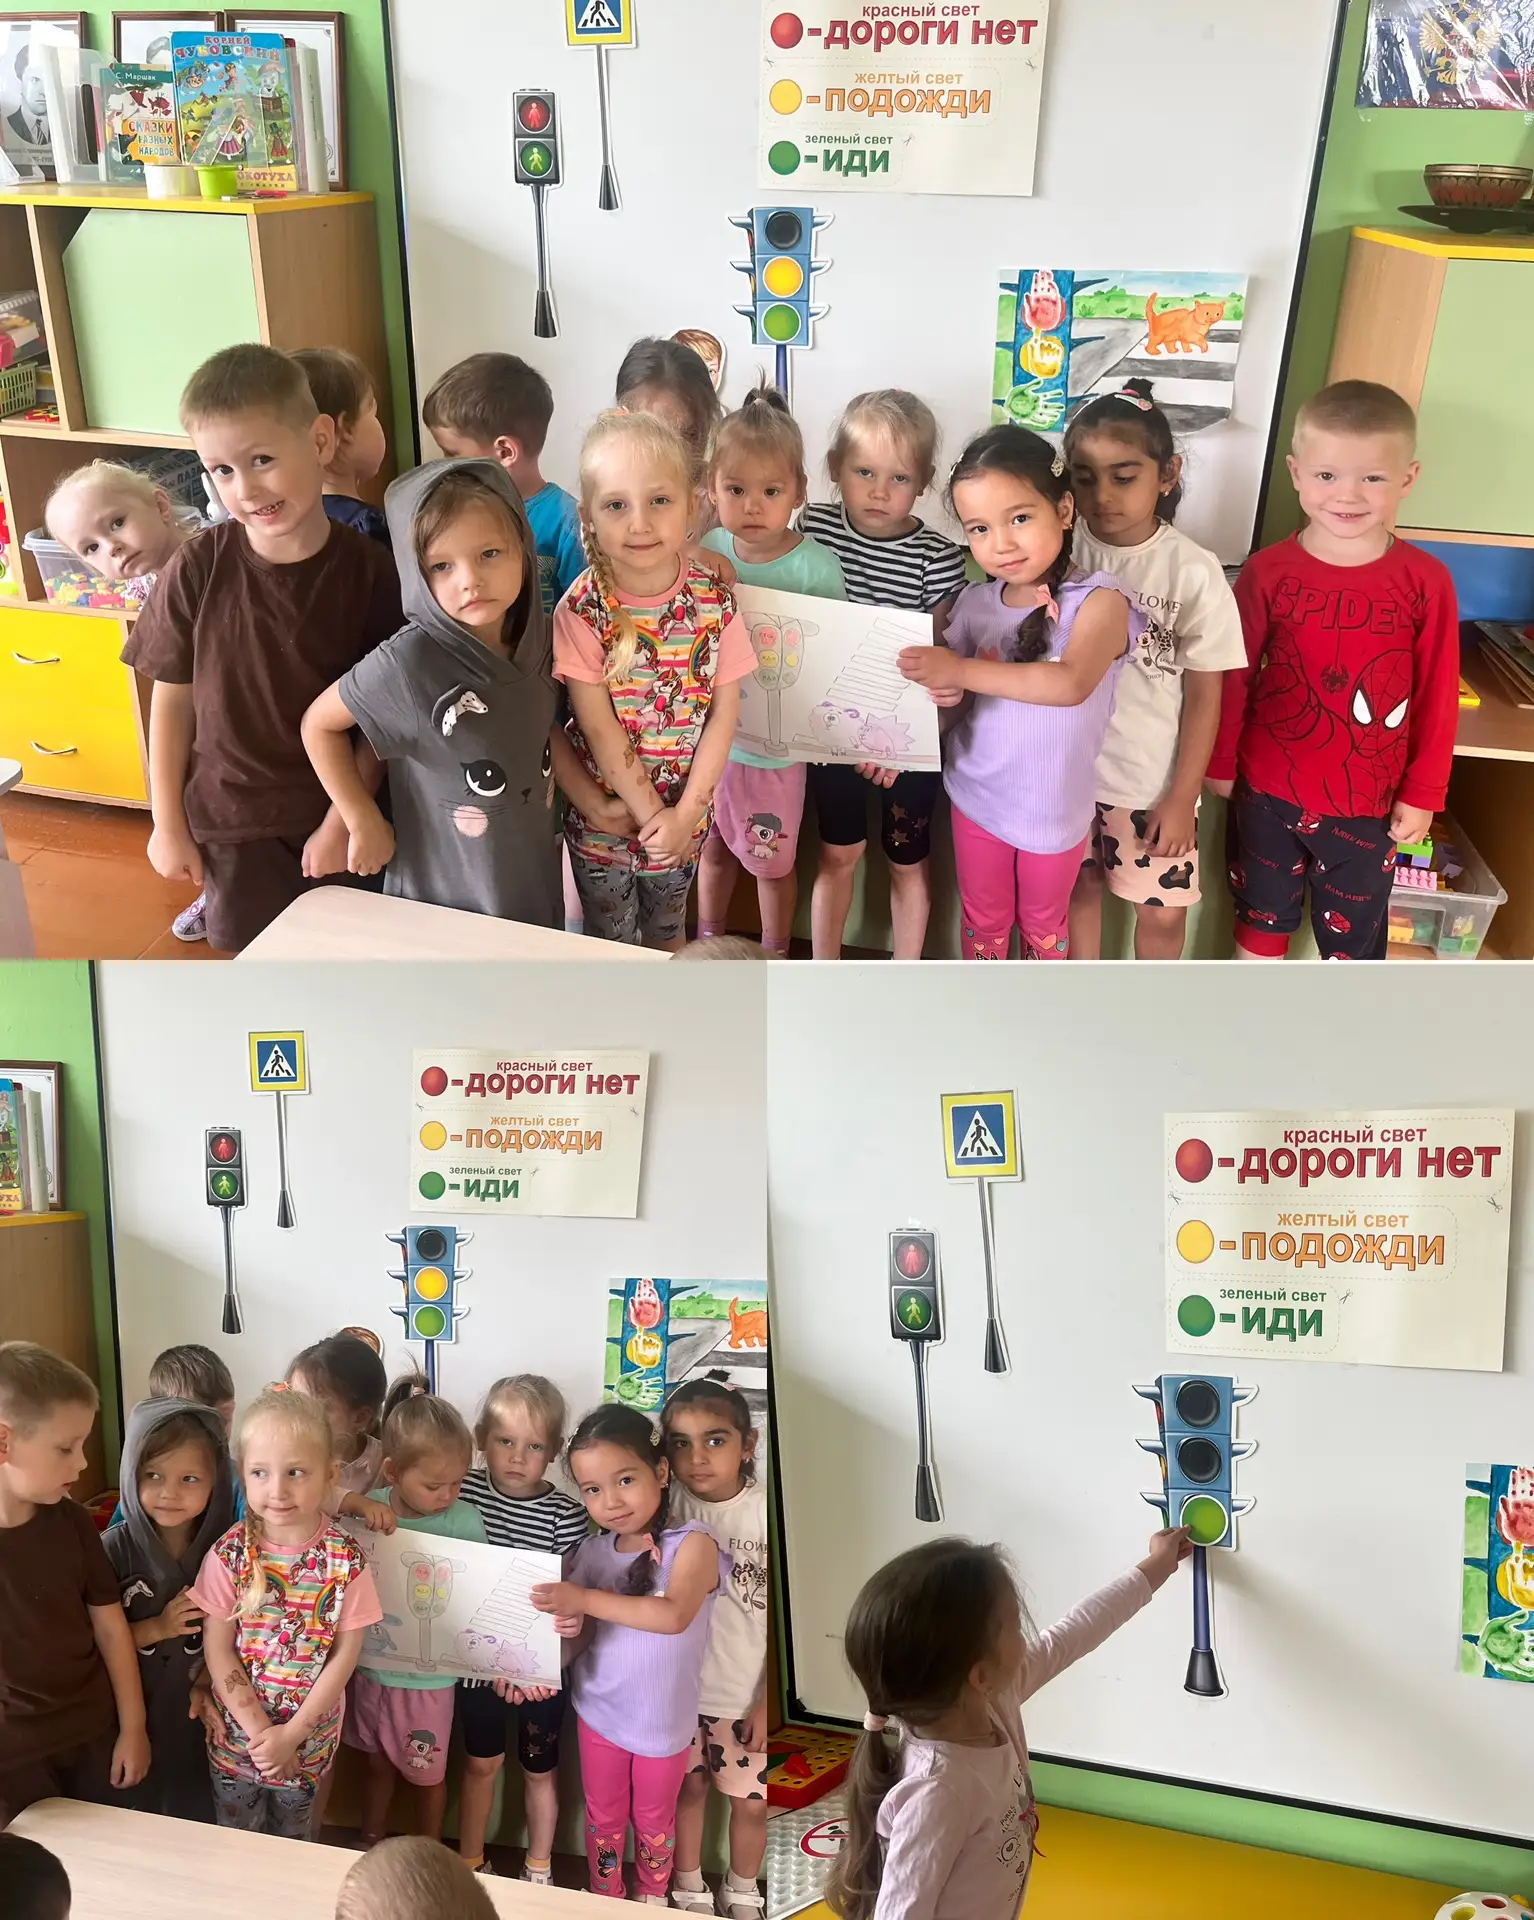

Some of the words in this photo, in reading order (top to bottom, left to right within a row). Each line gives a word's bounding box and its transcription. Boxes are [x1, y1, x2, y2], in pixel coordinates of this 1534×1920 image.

[862, 3, 935, 18] красный
[941, 5, 980, 17] свет
[971, 19, 1038, 46] нет
[205, 35, 251, 45] КОРНЕЙ
[174, 45, 280, 61] ЧУКОВСКИЙ
[116, 72, 123, 80] С.
[125, 72, 156, 81] Маршак
[855, 70, 920, 84] желтый
[925, 73, 963, 84] свет
[129, 121, 173, 133] СКАЗКИ
[138, 135, 173, 145] РАЗНЫХ
[805, 133, 861, 145] зеленый
[864, 136, 893, 145] свет
[139, 147, 174, 157] НАРОДОВ
[237, 172, 294, 181] ОКОТУХА
[1132, 590, 1183, 614] LOWE
[497, 1060, 557, 1072] красный
[561, 1062, 593, 1072] свет
[586, 1074, 640, 1095] нет
[490, 1115, 544, 1126] желтый
[548, 1118, 580, 1127] свет
[1283, 1125, 1374, 1147] красный
[1380, 1127, 1427, 1142] свет
[1418, 1146, 1501, 1178] нет
[449, 1165, 495, 1175] зеленый
[498, 1167, 522, 1176] свет
[1277, 1210, 1357, 1228] желтый
[1363, 1214, 1409, 1228] свет
[1219, 1287, 1287, 1302] зеленый
[1291, 1290, 1327, 1302] свет
